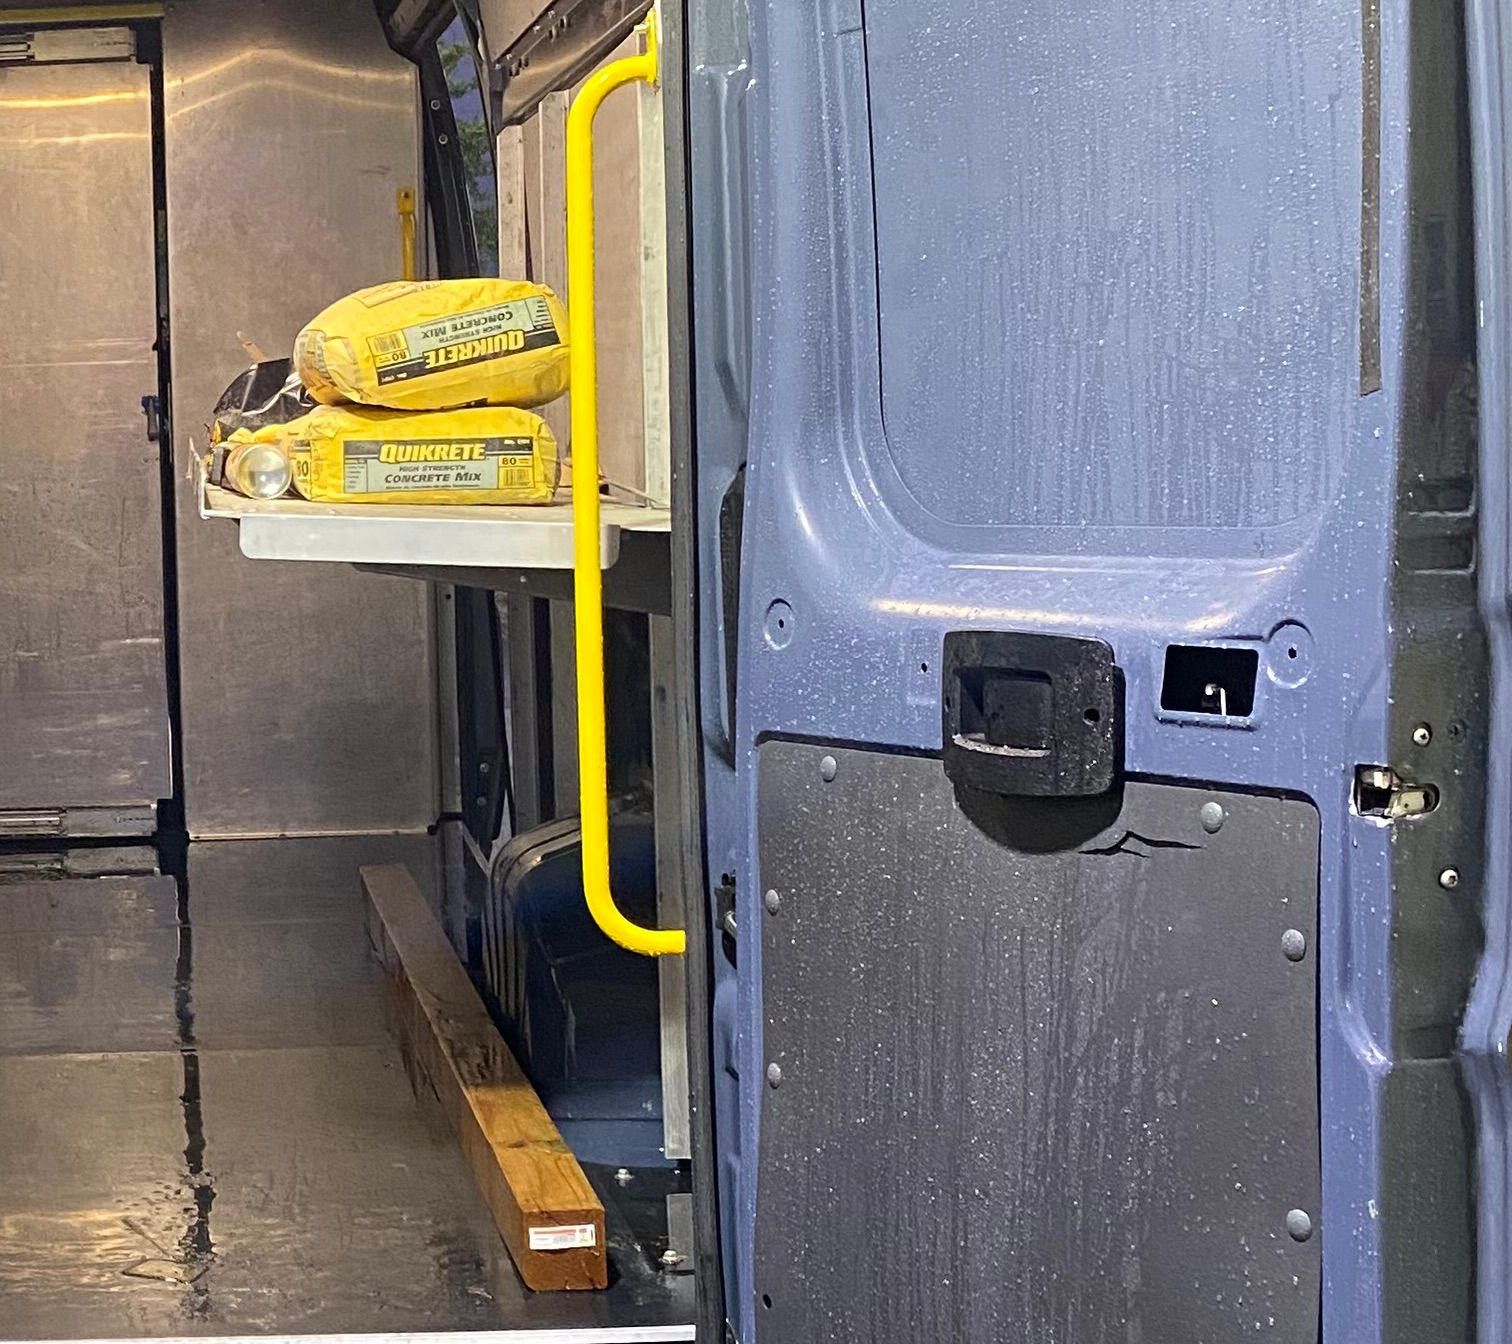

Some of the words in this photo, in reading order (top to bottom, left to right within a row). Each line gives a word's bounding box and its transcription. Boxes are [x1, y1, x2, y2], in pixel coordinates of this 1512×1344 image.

[452, 311, 513, 332] CONCRETE
[421, 326, 447, 340] MIX
[424, 330, 525, 368] QUIKRETE
[379, 443, 486, 464] QUIKRETE
[422, 464, 466, 472] STRENGTH
[502, 457, 517, 465] 80
[384, 473, 450, 484] CONCRETE
[455, 472, 481, 482] MIX
